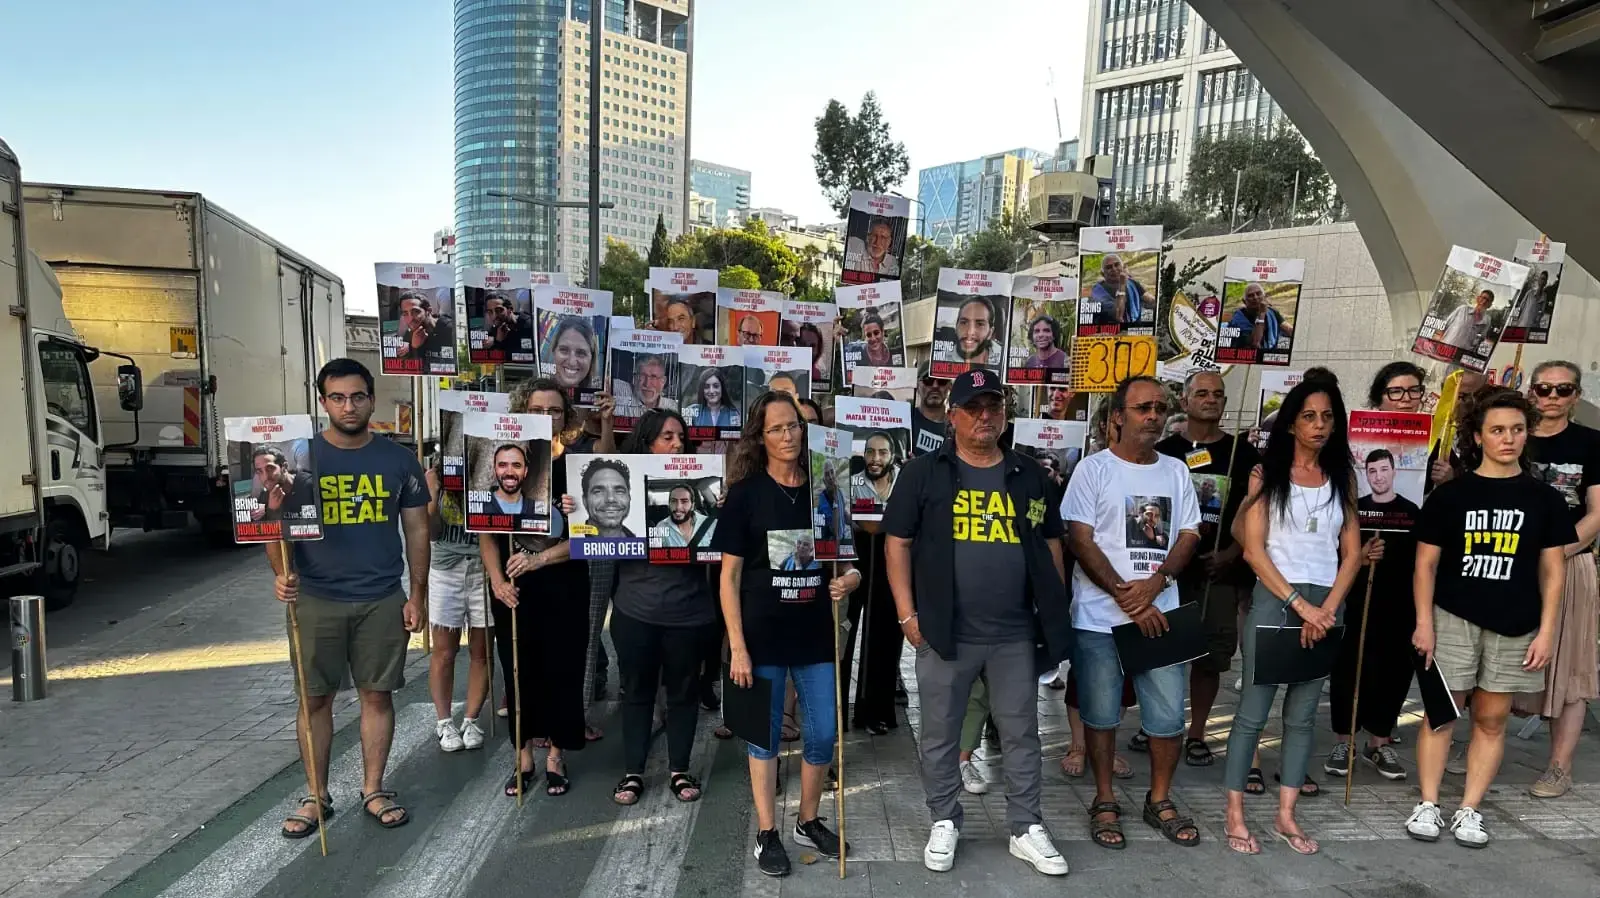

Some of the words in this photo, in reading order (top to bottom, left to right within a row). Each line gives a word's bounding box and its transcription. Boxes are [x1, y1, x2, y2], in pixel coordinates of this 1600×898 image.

[1081, 302, 1101, 313] BRING
[1080, 313, 1093, 324] HIM
[1424, 316, 1446, 330] BRING
[470, 331, 488, 340] BRING
[1080, 326, 1098, 335] HOME
[1220, 327, 1240, 338] BRING
[1420, 327, 1435, 338] HIM
[383, 336, 404, 347] BRING
[471, 340, 483, 349] HIM
[934, 340, 954, 350] BRING
[1218, 338, 1232, 348] HIM
[383, 347, 397, 358] HIM
[846, 352, 862, 361] BRING
[933, 351, 946, 361] HIM
[1010, 346, 1030, 357] BRING
[540, 362, 556, 374] BRING
[932, 362, 950, 372] HOME
[1010, 358, 1022, 368] HIM
[1008, 369, 1027, 379] HOME
[682, 408, 699, 418] BRING
[444, 456, 463, 466] BRING
[444, 466, 456, 476] HIM
[320, 474, 390, 500] SEAL
[468, 491, 492, 502] BRING
[235, 498, 258, 510] BRING
[468, 502, 484, 514] HIM
[236, 511, 251, 522] HIM
[322, 500, 388, 524] DEAL
[469, 515, 490, 526] HOME
[492, 515, 514, 526] NOW!
[1465, 510, 1488, 530] הם
[1492, 509, 1524, 531] למה
[238, 524, 257, 536] HOME
[262, 522, 282, 534] NOW!
[649, 527, 670, 537] BRING
[953, 516, 1020, 544] DEAL
[649, 538, 662, 548] HIM
[1464, 532, 1520, 554] עדיין
[584, 542, 615, 556] BRING
[618, 542, 644, 556] OFER
[1130, 552, 1148, 560] BRING
[1134, 562, 1150, 572] HOME
[1462, 555, 1514, 580] בעזה?
[772, 576, 791, 588] BRING
[792, 577, 806, 588] GADI
[781, 588, 800, 599] HOME
